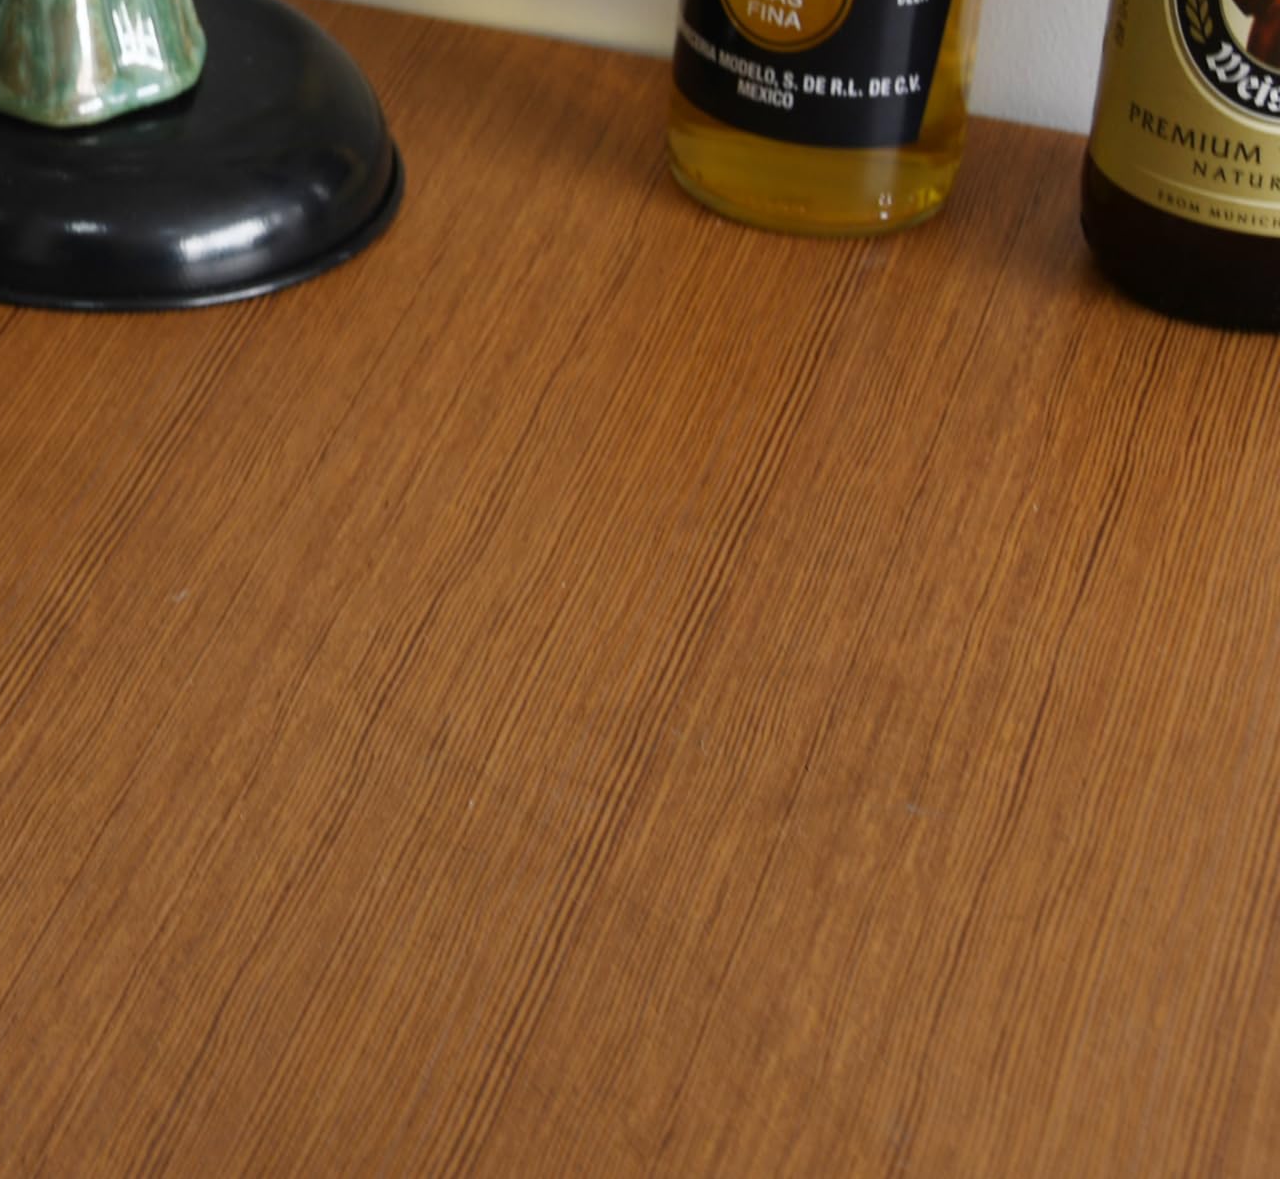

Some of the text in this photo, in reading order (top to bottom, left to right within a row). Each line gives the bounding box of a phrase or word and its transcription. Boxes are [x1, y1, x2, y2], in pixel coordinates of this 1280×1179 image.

[737, 79, 795, 110] MEXICO
[783, 71, 799, 92] S.
[803, 73, 826, 95] DE
[830, 77, 863, 98] R.L.
[868, 77, 892, 98] DE
[1129, 100, 1261, 165] PREMIUM
[1193, 159, 1280, 191] NATUR
[1157, 188, 1201, 214] FROM
